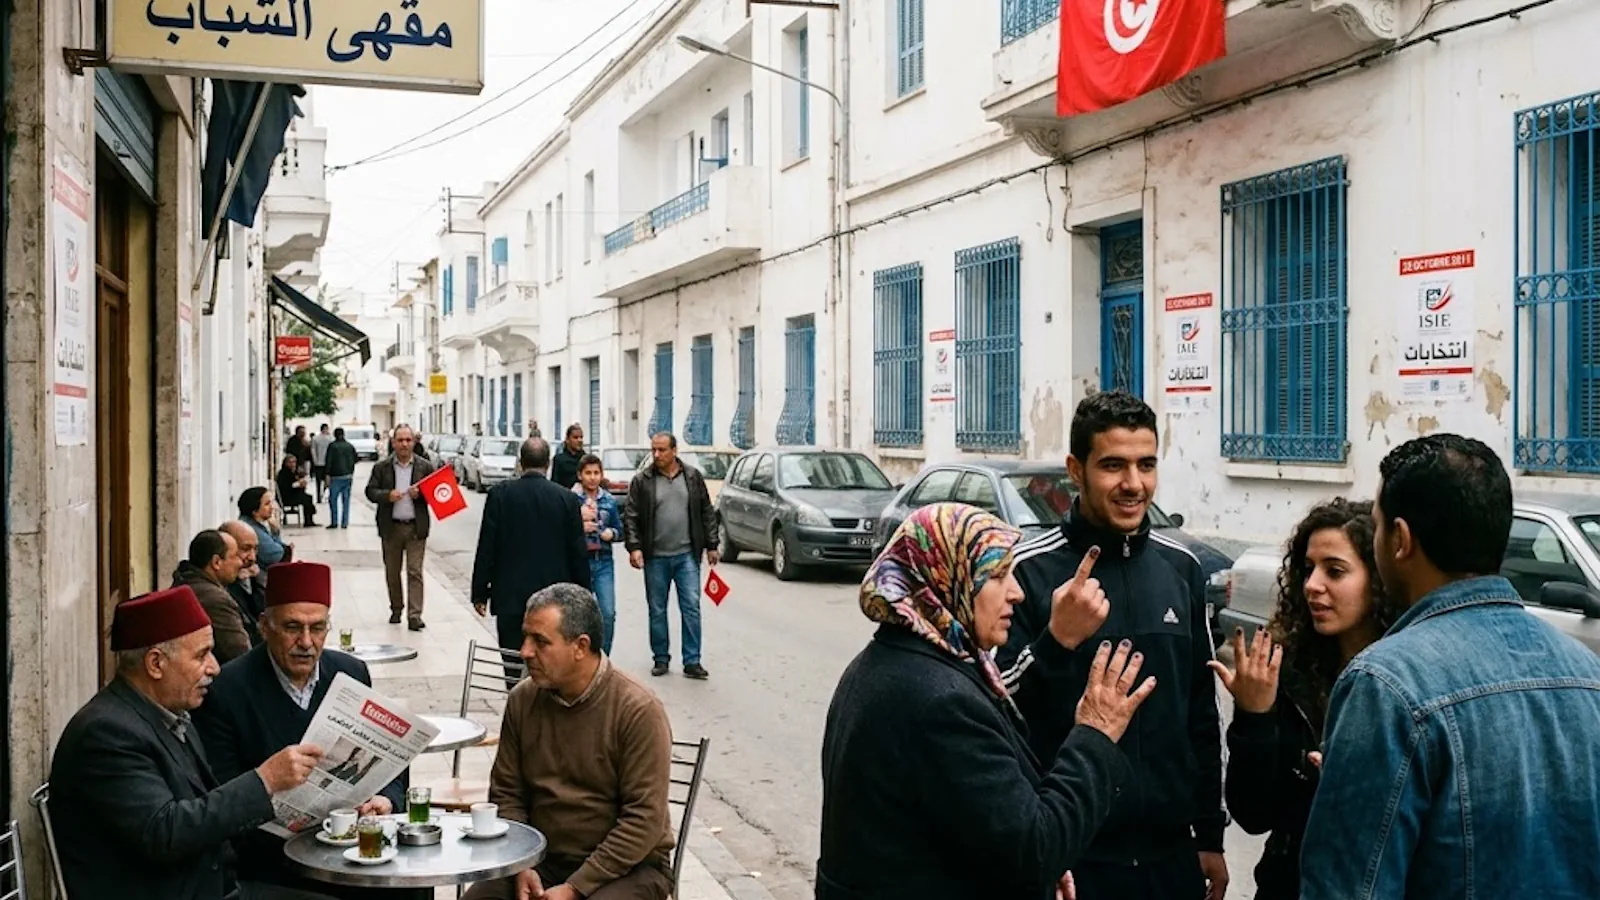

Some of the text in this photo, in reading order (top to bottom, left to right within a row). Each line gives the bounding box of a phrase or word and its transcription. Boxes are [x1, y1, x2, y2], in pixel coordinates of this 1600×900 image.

[146, 0, 452, 62] مقهى الشباب
[1419, 313, 1452, 329] ISIE
